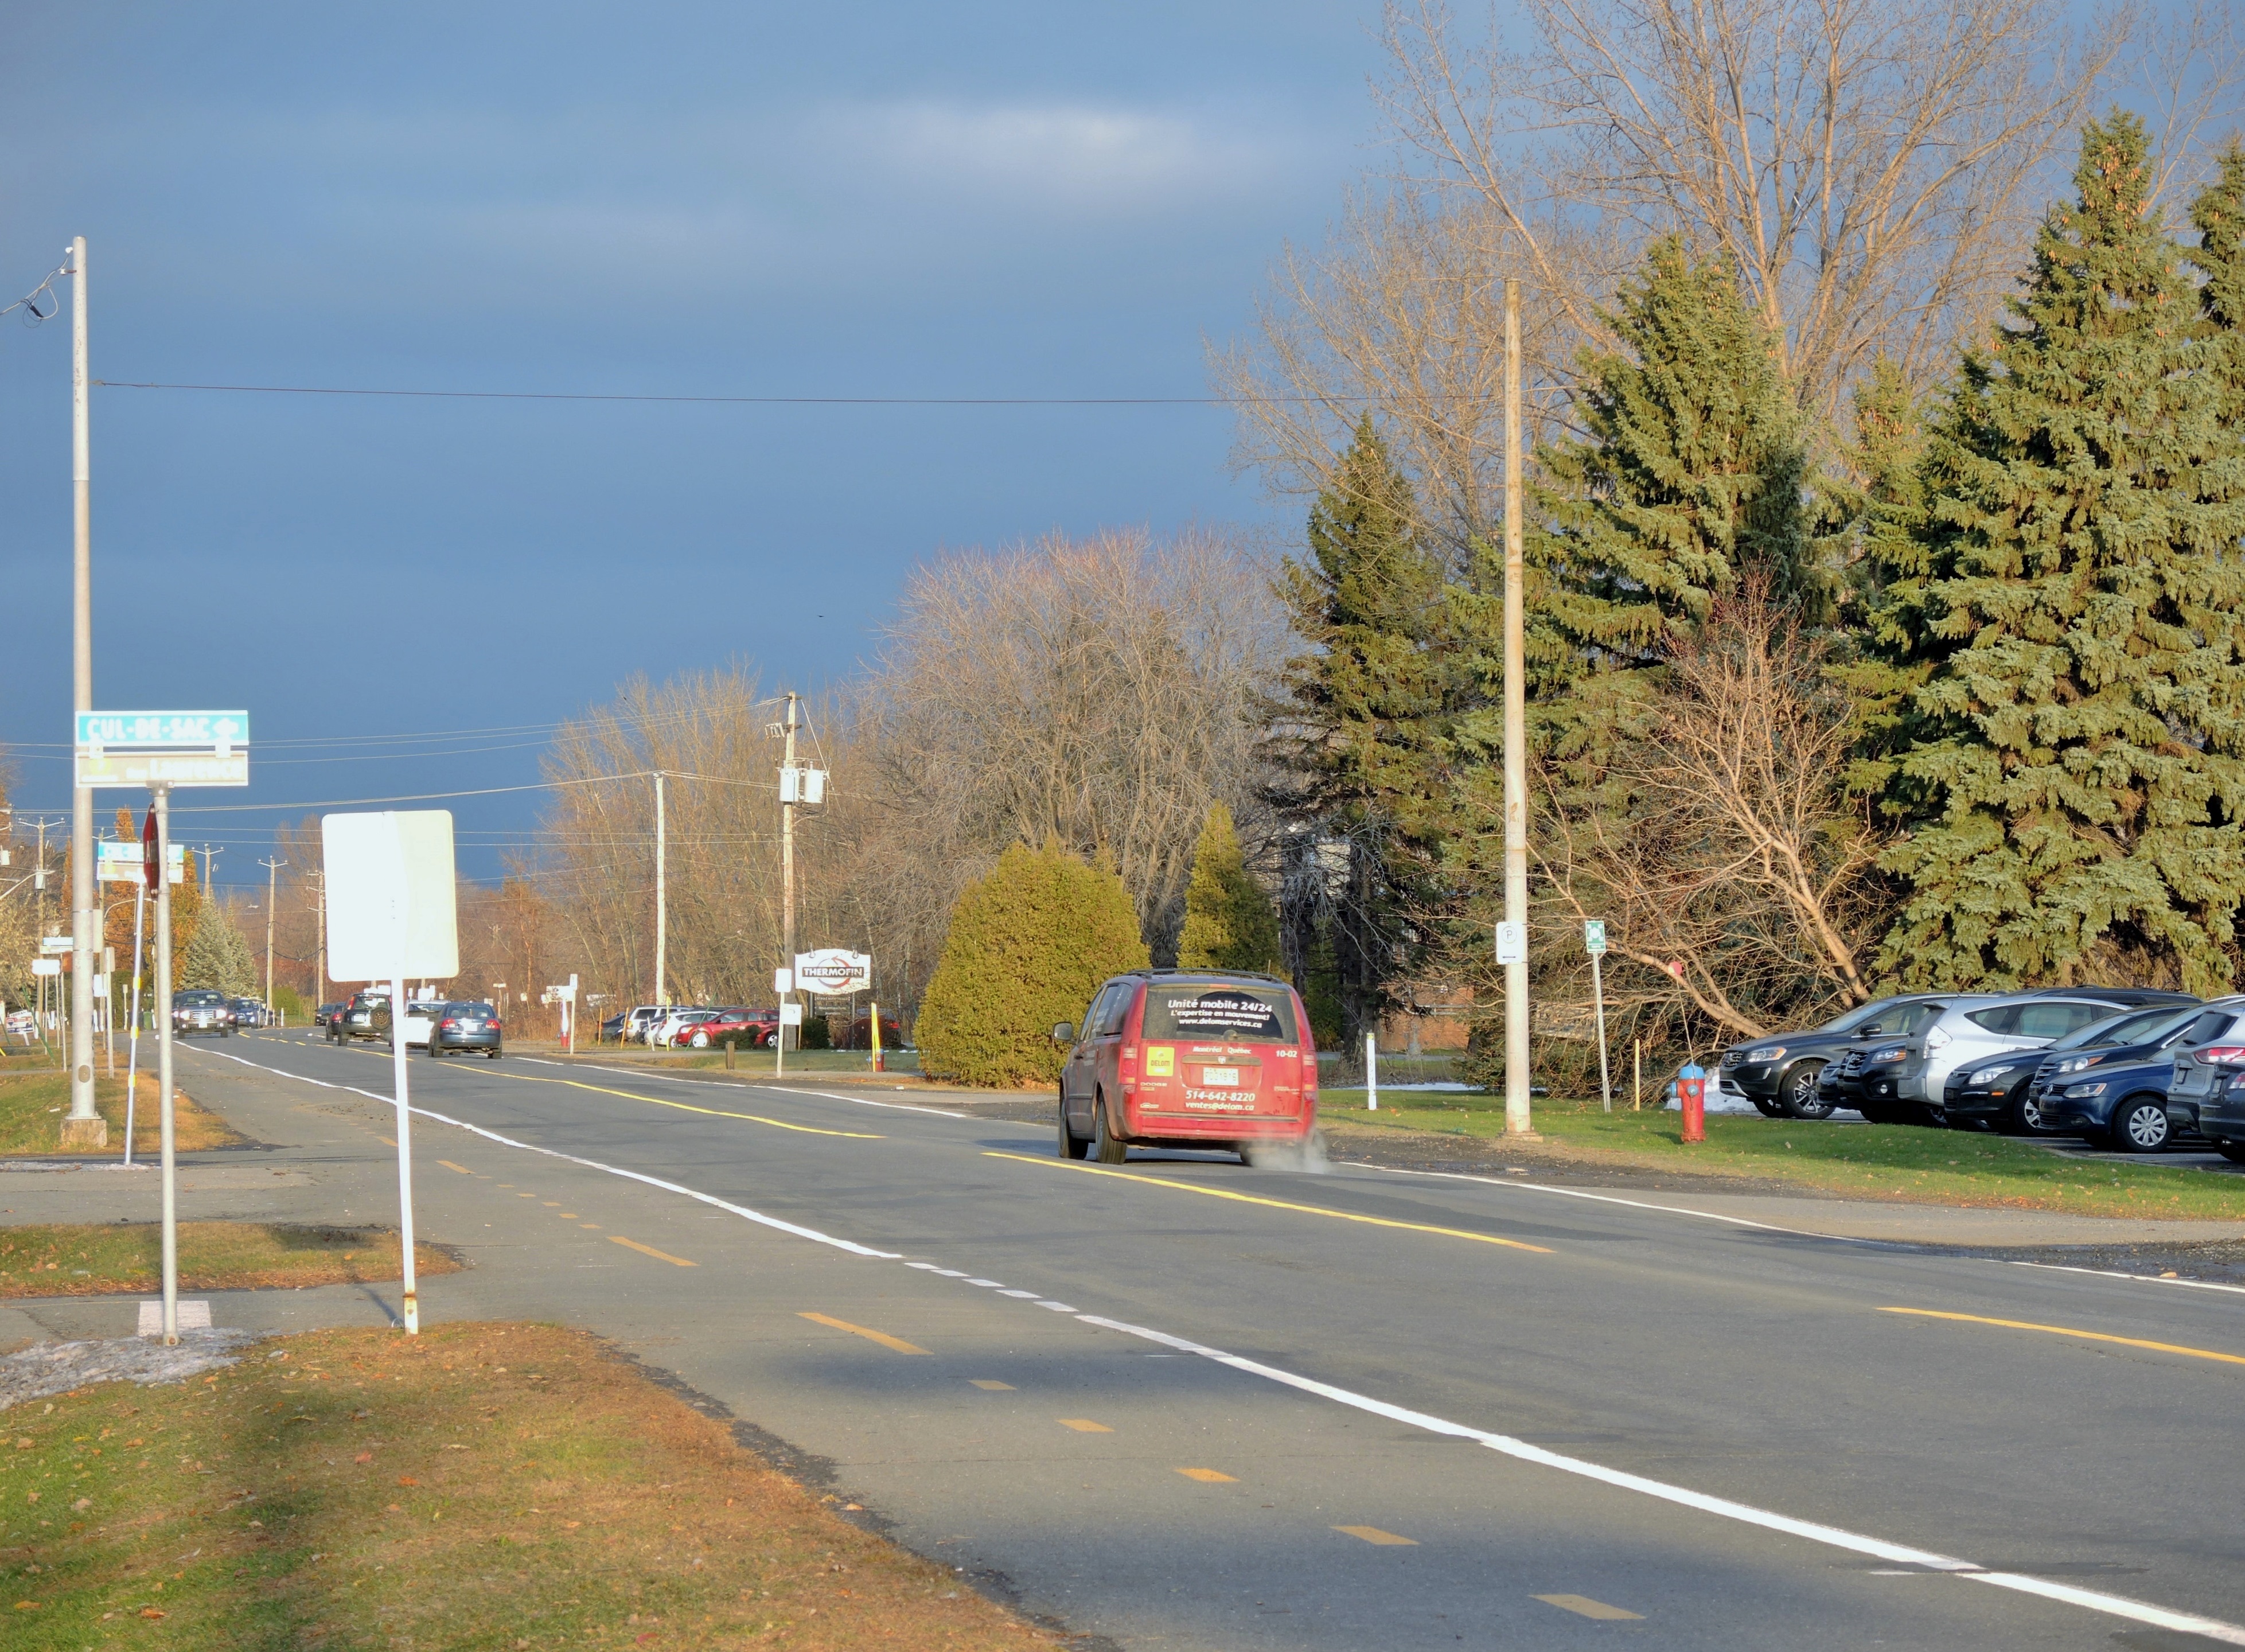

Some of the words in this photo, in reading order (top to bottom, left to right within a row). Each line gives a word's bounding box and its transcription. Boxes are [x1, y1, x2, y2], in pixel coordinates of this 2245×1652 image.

[87, 718, 210, 739] CUL-DE-SAC
[804, 968, 863, 976] THERMOFIN
[1168, 999, 1198, 1008] Unité
[1200, 1000, 1238, 1010] mobile
[1240, 1002, 1272, 1012] 24/24
[1171, 1009, 1213, 1017] L'expertise
[1225, 1011, 1270, 1020] mouvement!
[1178, 1018, 1262, 1028] www.delomservices.ca
[1276, 1050, 1297, 1058] 10-02
[1185, 1090, 1256, 1102] 514-642-8220
[1185, 1101, 1255, 1111] ventes@delom.ca
